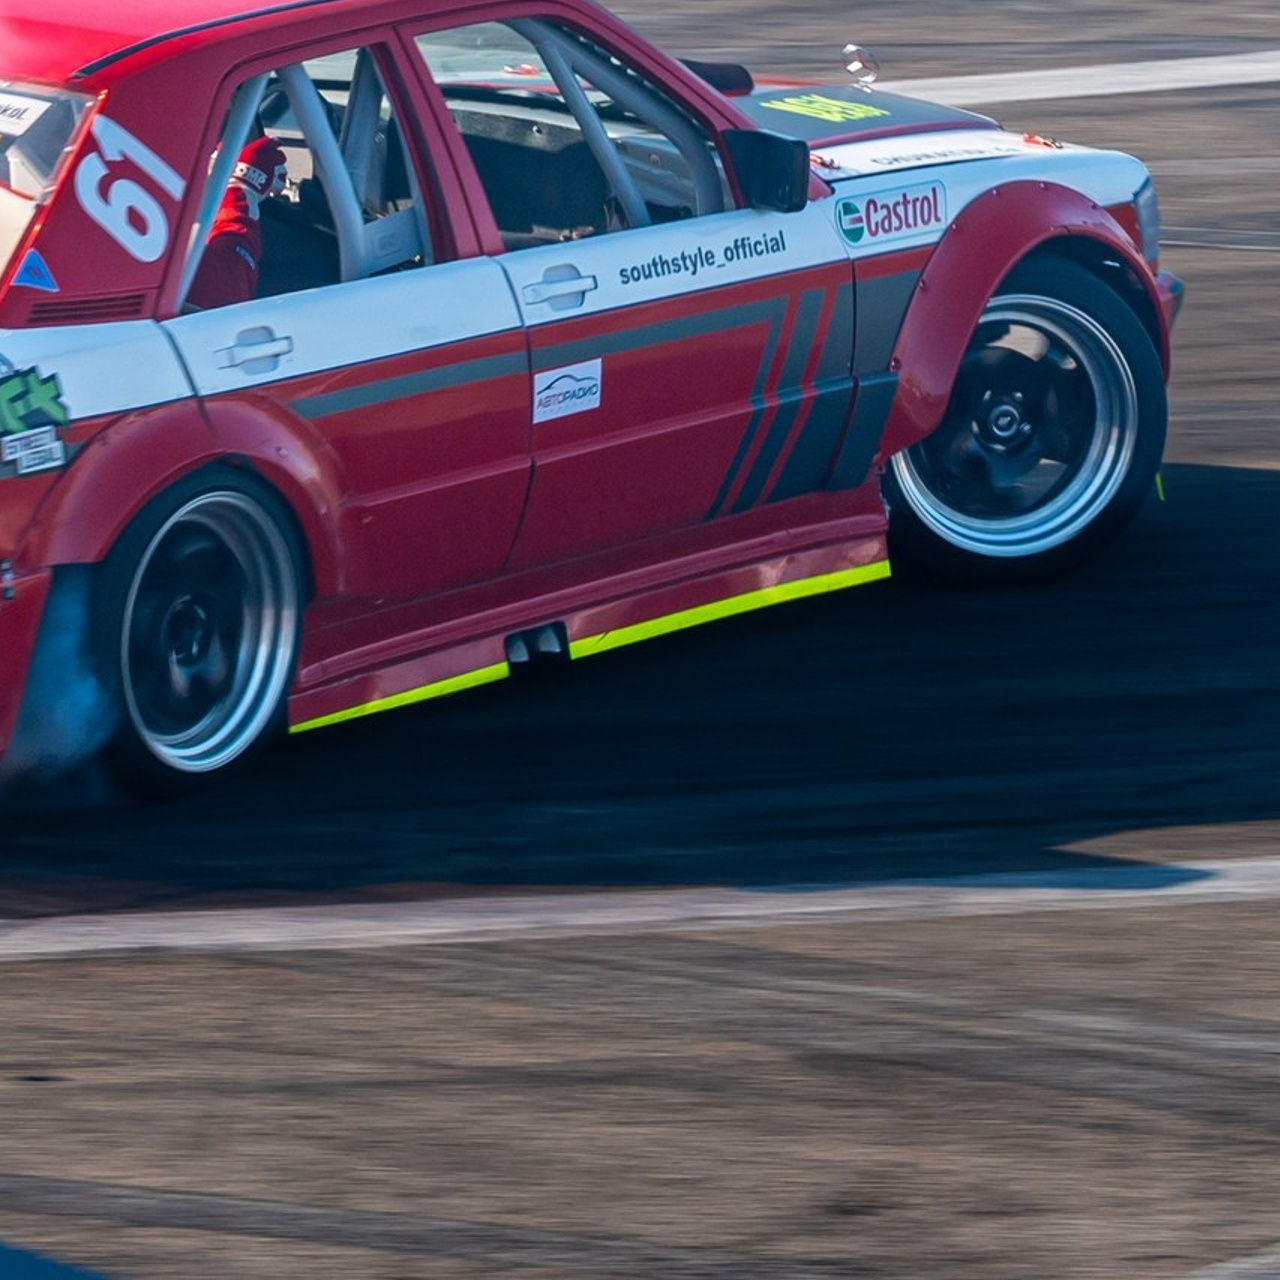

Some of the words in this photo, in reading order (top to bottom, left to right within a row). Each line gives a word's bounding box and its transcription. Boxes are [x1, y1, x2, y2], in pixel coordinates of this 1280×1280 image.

[74, 113, 187, 262] 61
[864, 186, 942, 238] Castrol
[618, 229, 787, 285] southstyle_official
